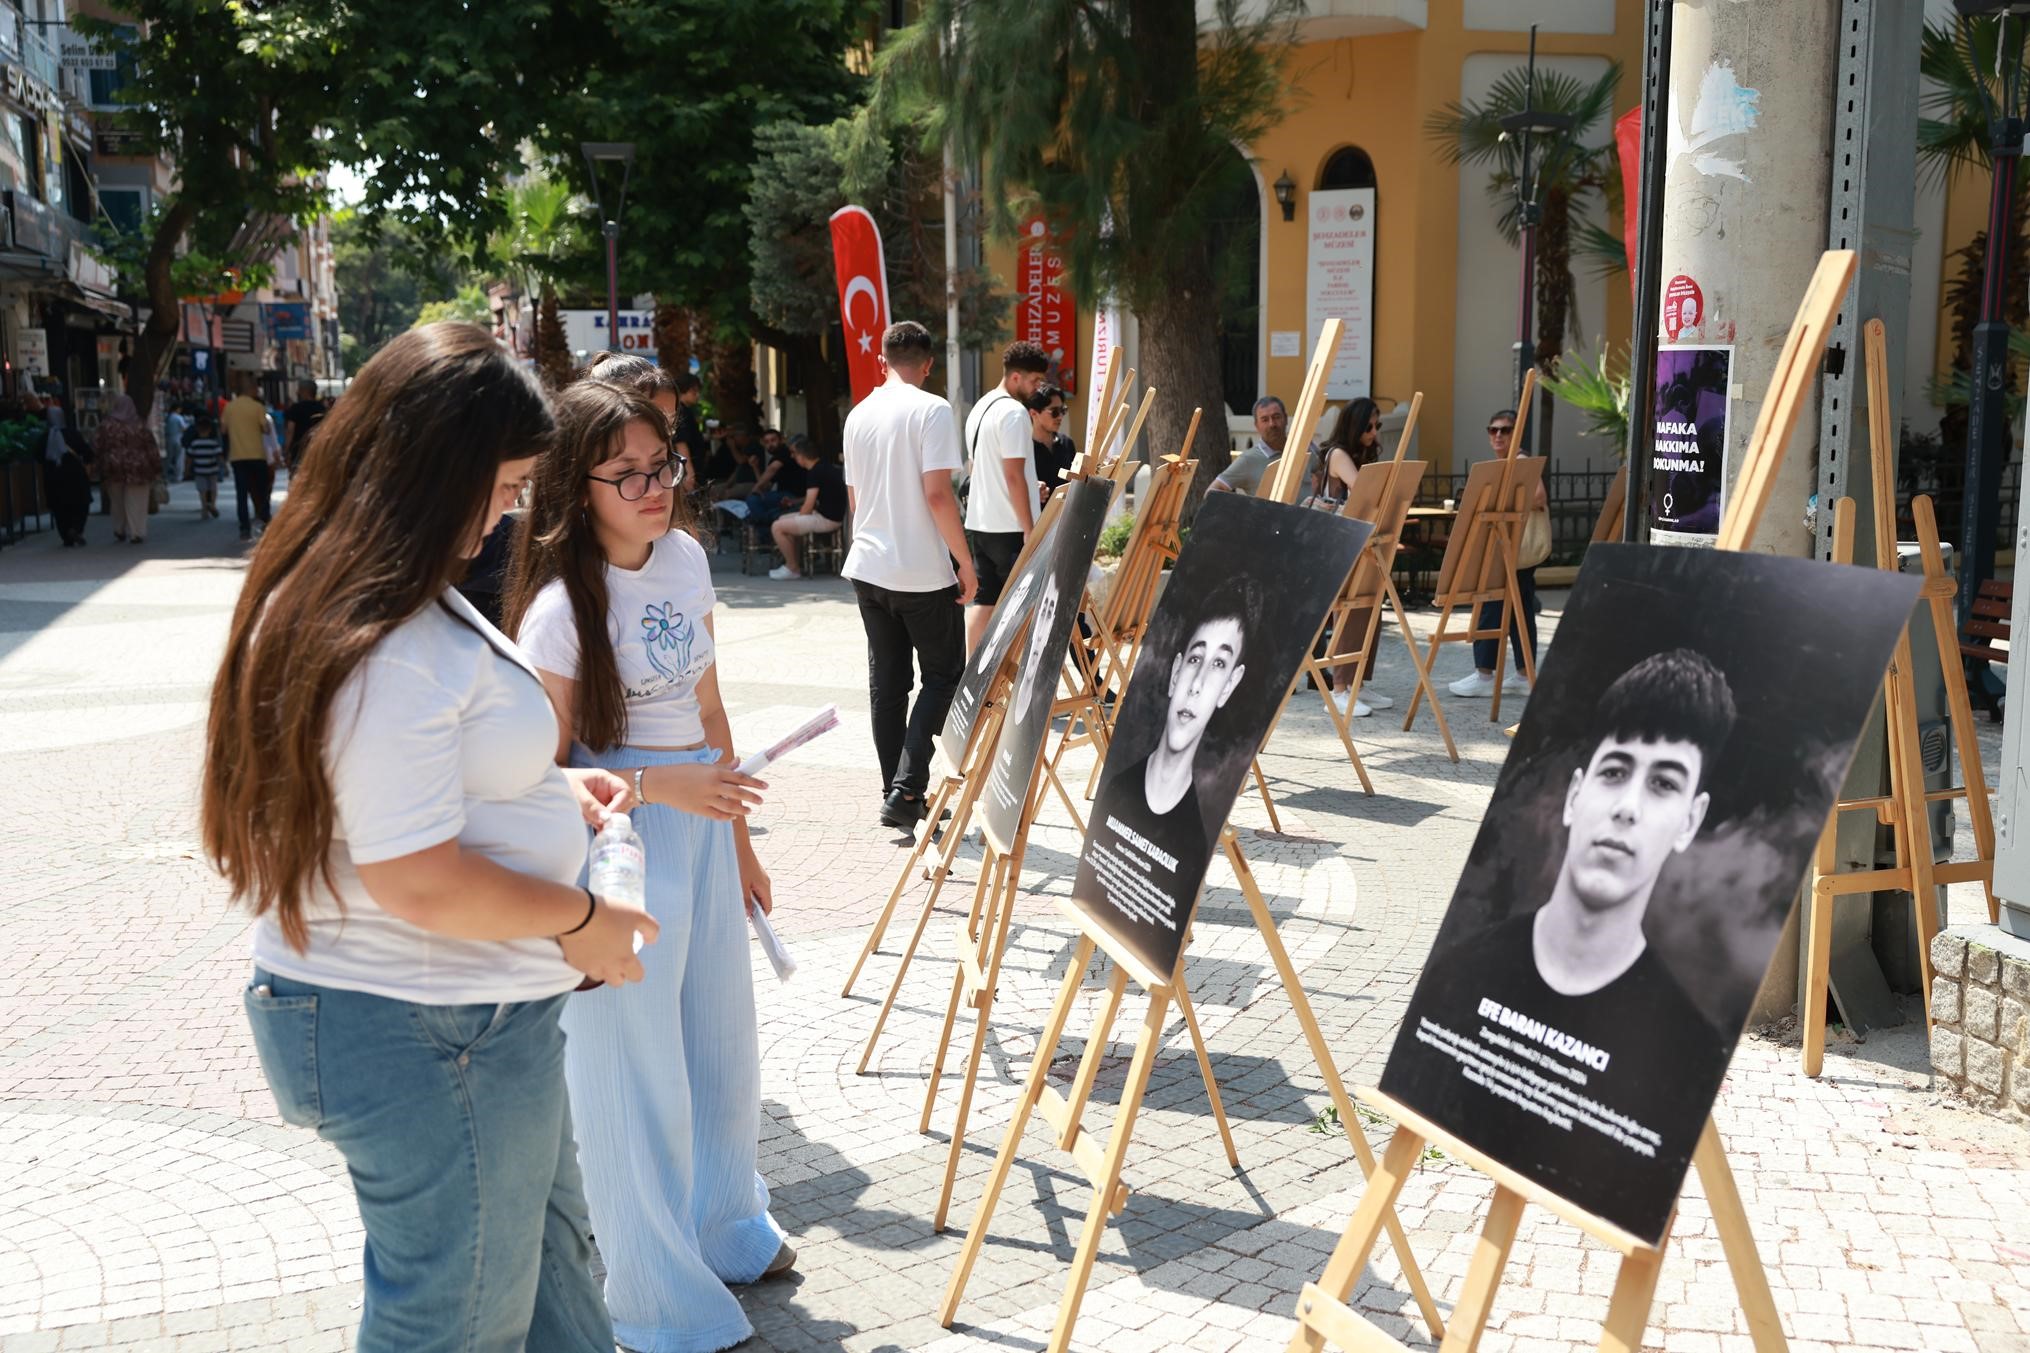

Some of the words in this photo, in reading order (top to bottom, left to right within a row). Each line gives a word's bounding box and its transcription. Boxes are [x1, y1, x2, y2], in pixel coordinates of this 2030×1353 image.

[1477, 997, 1502, 1021] EFE
[1498, 1006, 1547, 1042] BARAN
[1542, 1027, 1610, 1072] KAZANCI
